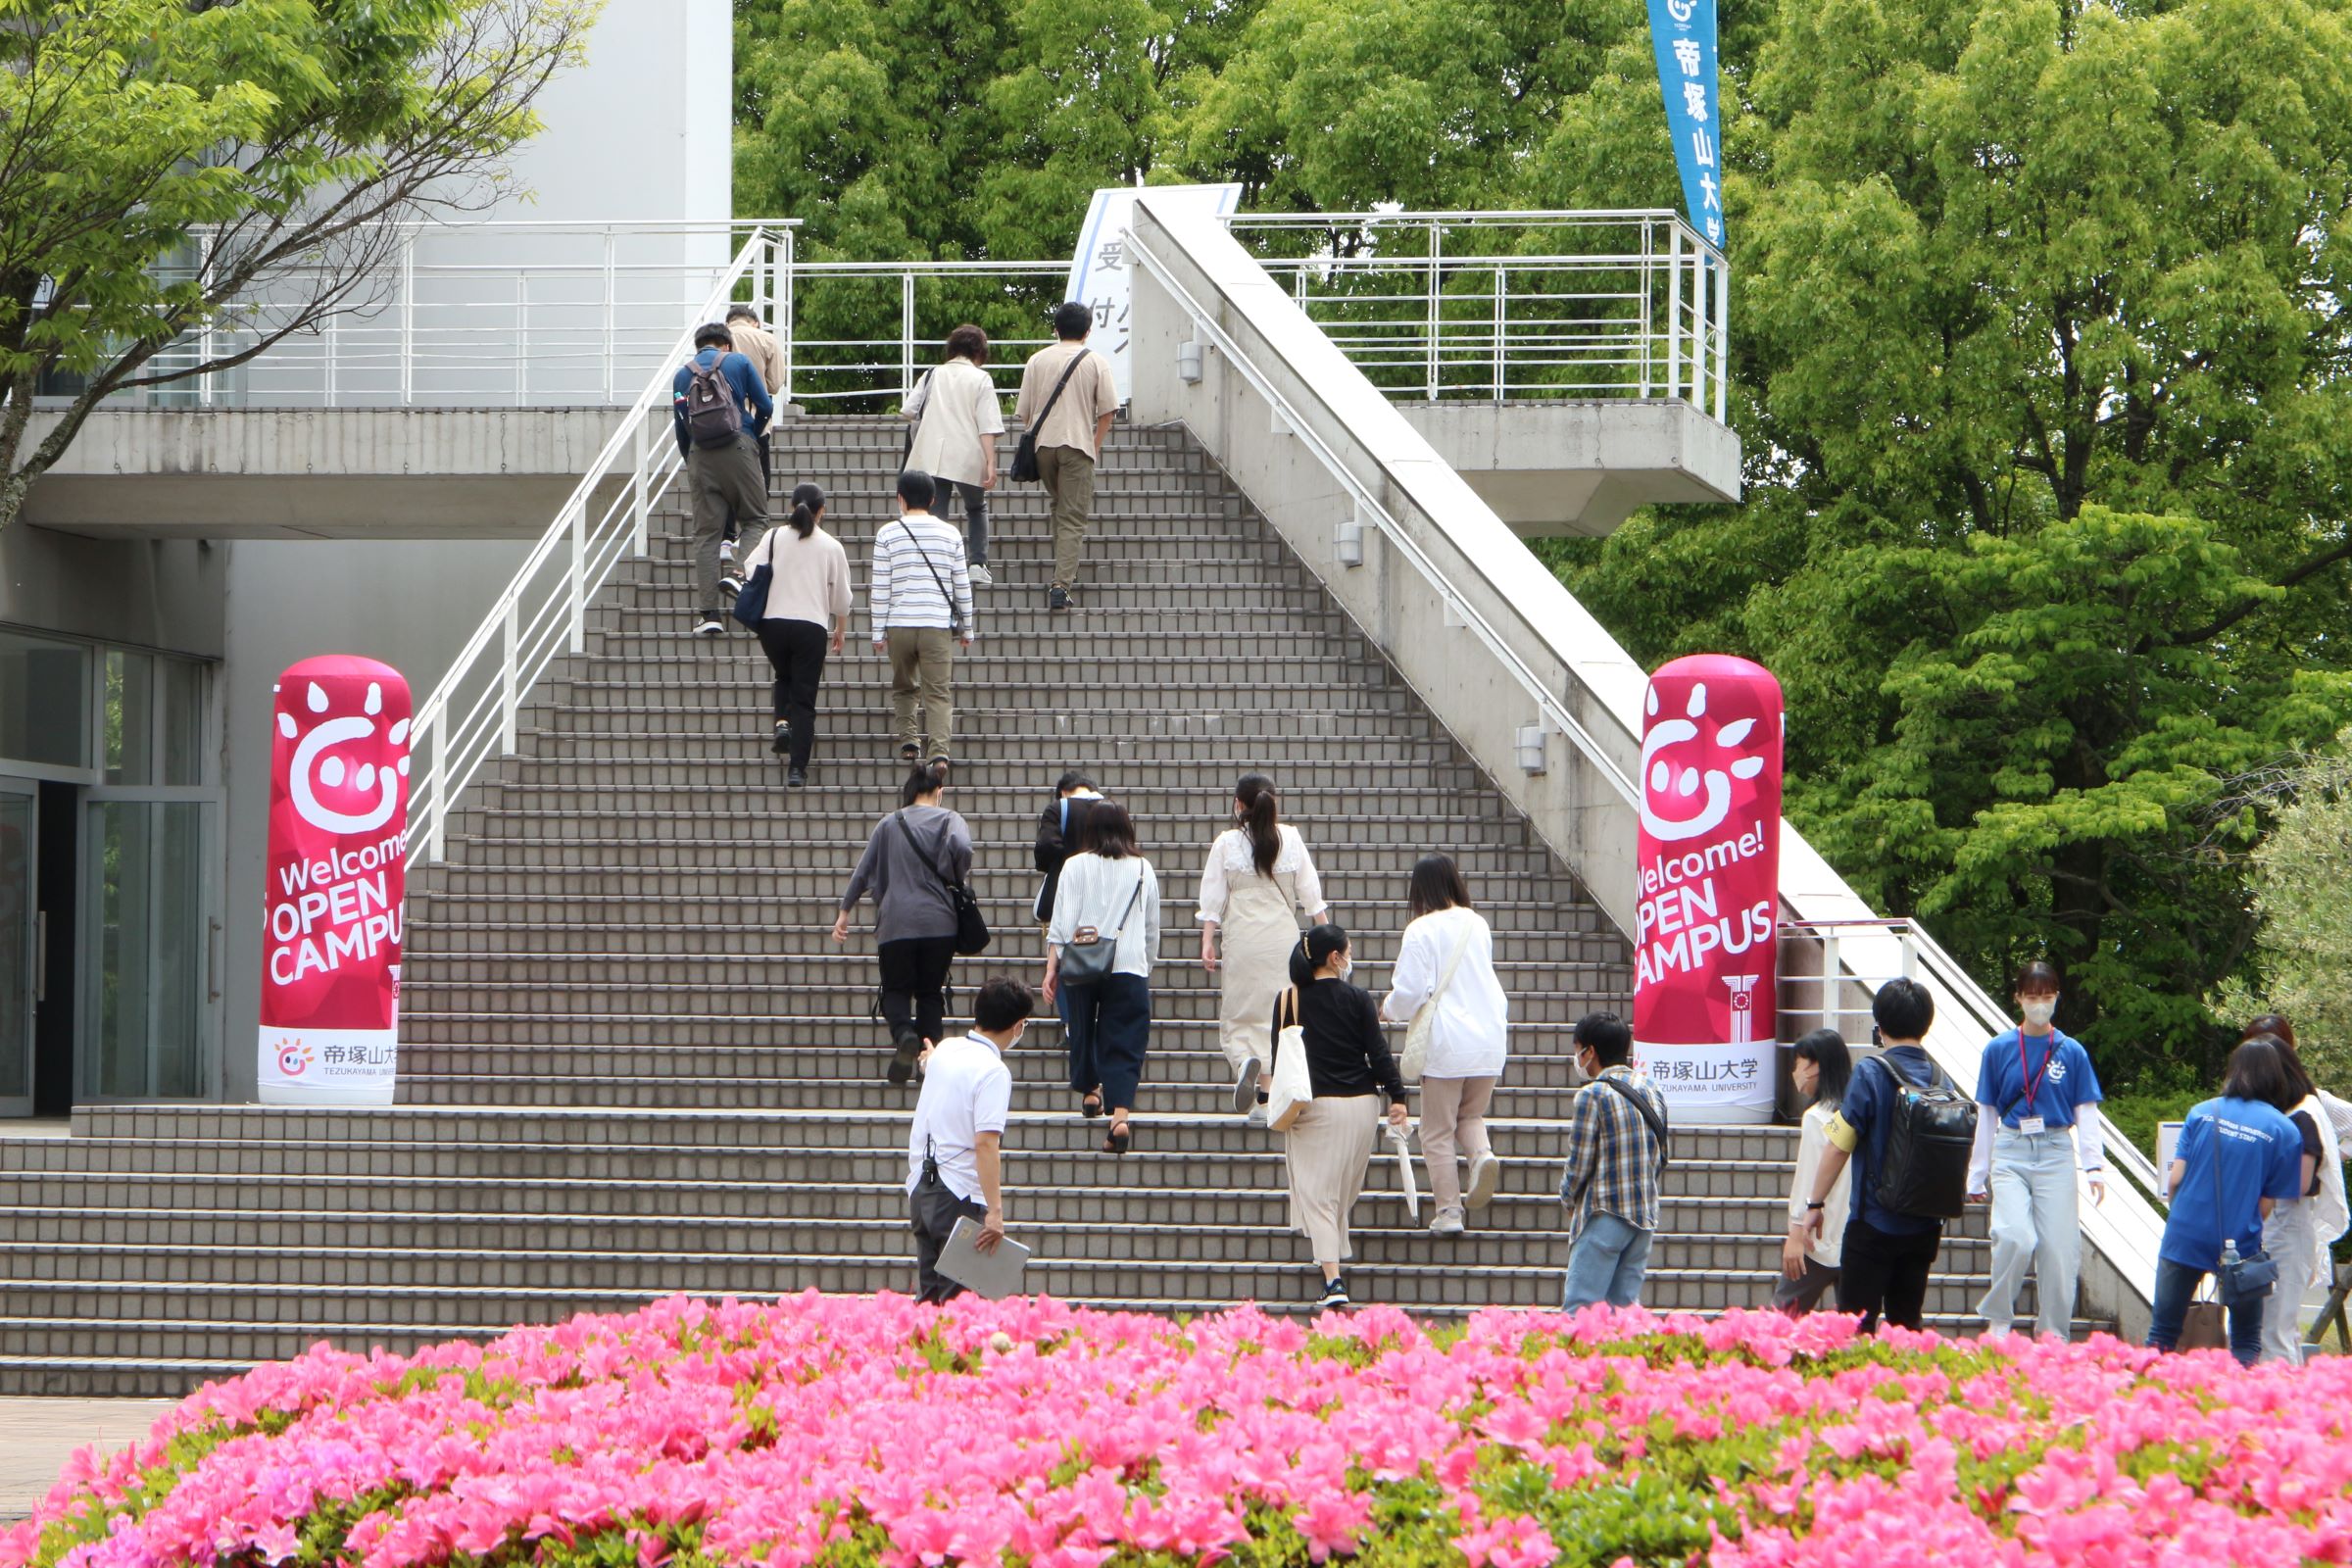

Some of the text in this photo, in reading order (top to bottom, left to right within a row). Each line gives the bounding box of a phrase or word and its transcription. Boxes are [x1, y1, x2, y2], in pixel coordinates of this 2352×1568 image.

[272, 870, 388, 943] OPEN
[1634, 900, 1772, 995] AMPUS
[323, 1045, 397, 1065] 帝塚山大
[323, 1067, 377, 1076] TEZUKAYAMA
[1652, 1057, 1758, 1081] 帝塚山大学
[1660, 1081, 1757, 1093] ZUKAYAMA UNIVERSITY
